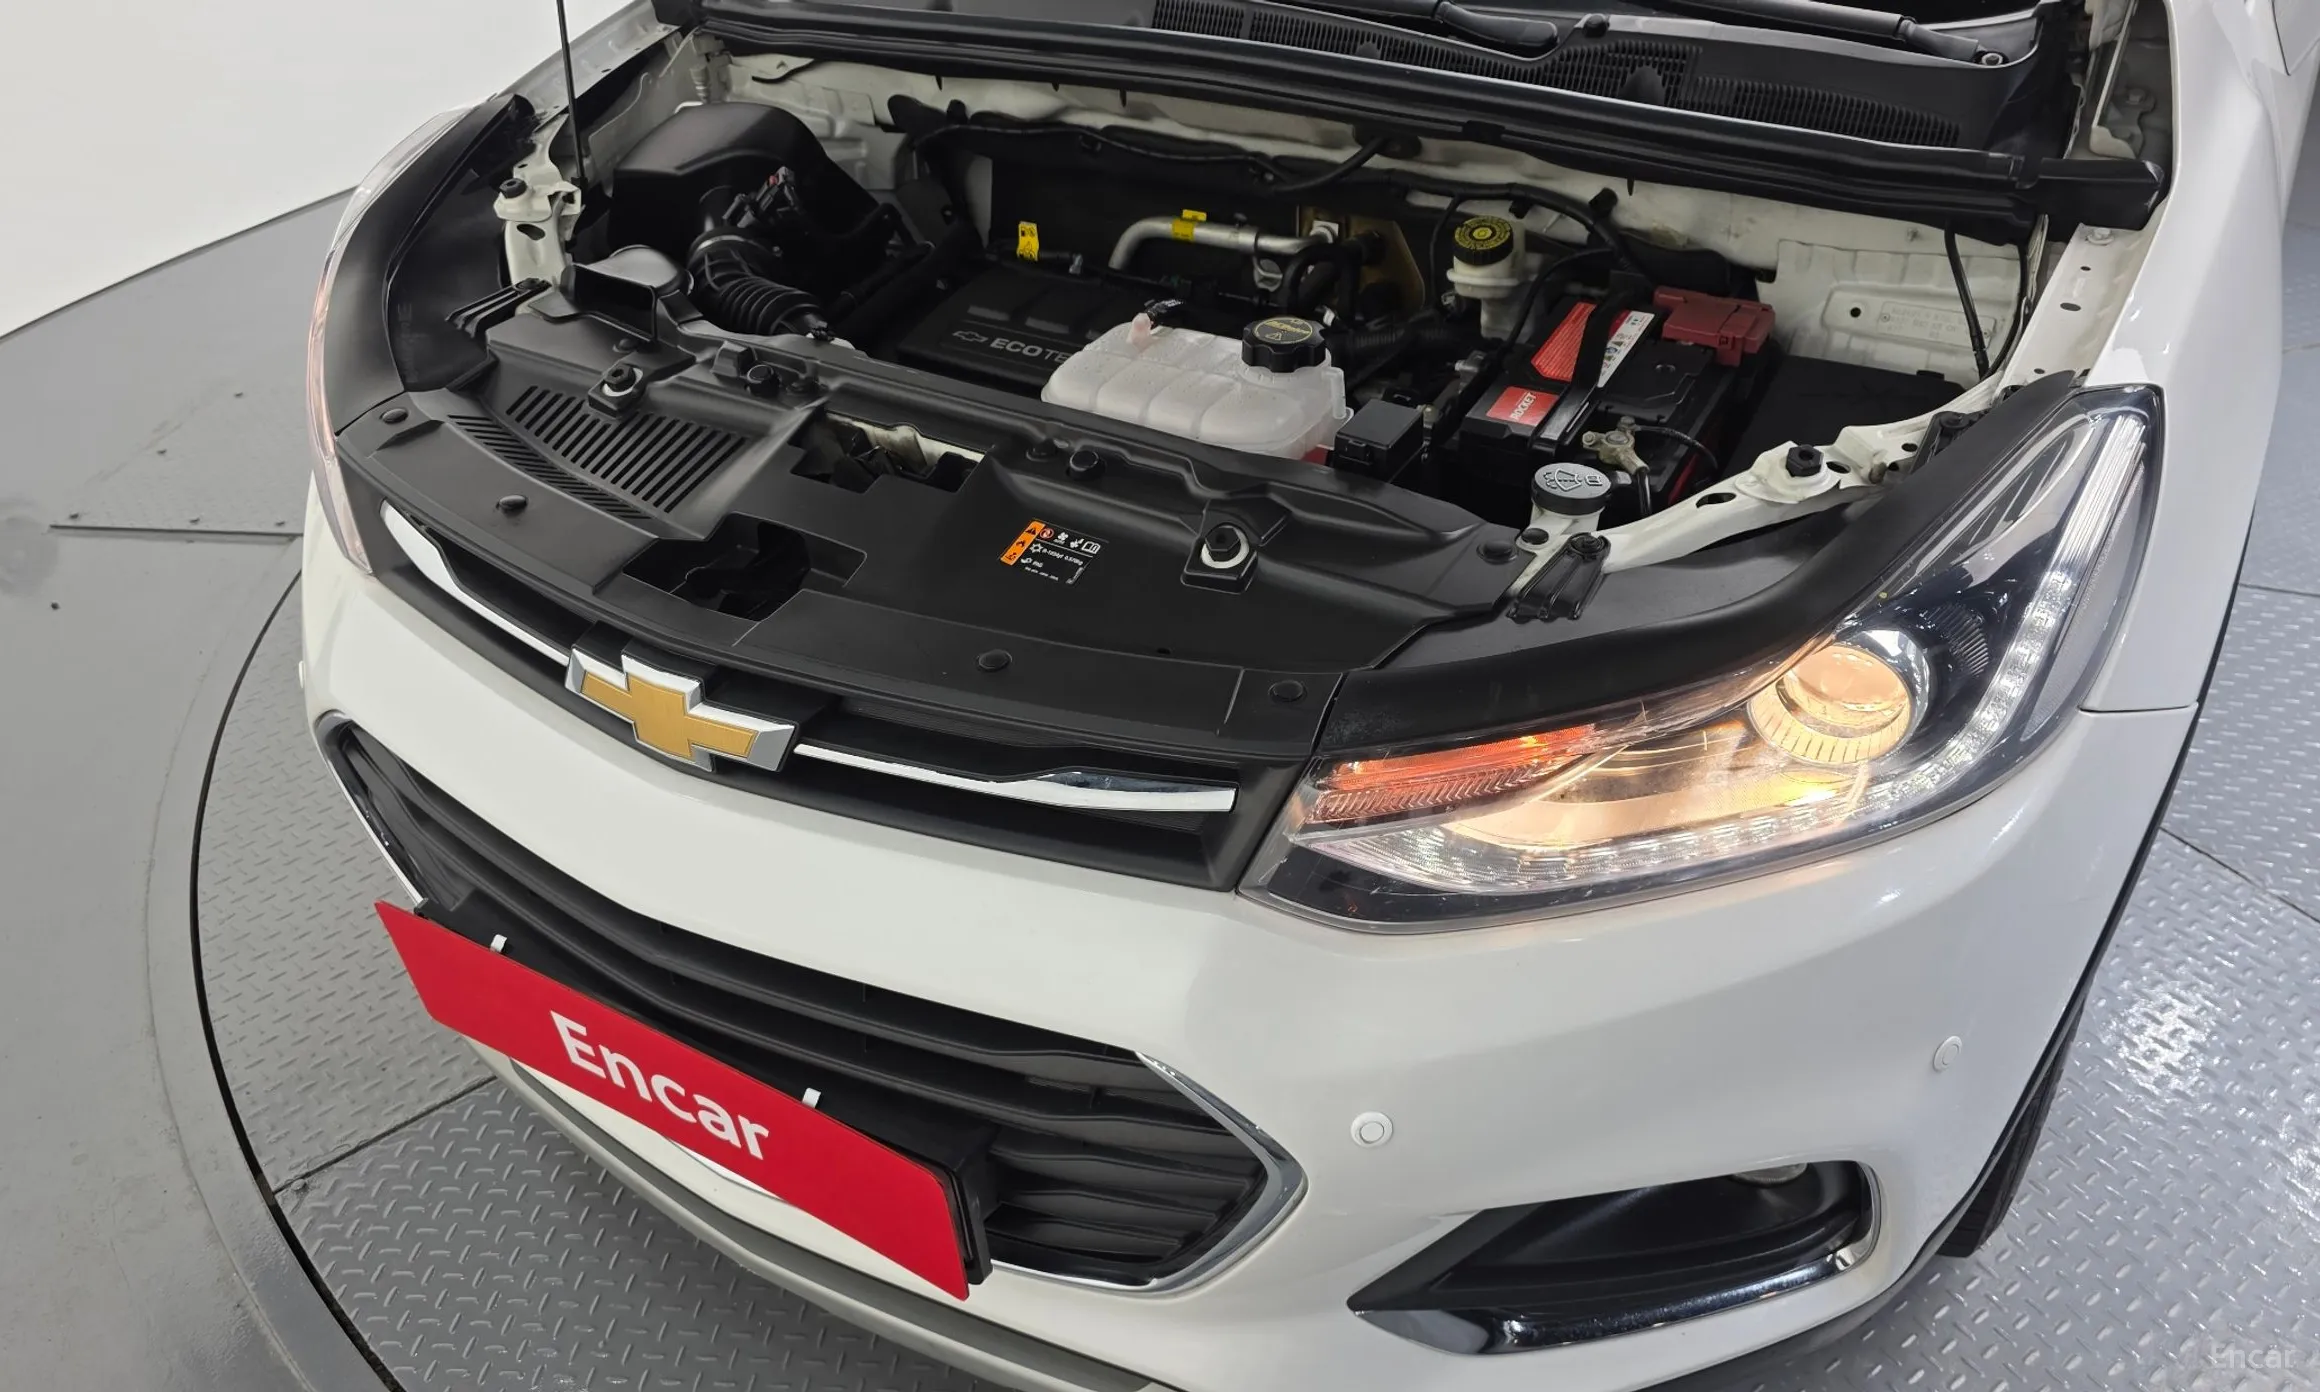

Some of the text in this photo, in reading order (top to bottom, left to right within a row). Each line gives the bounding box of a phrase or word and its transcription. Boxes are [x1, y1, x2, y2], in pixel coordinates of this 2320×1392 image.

[990, 337, 1075, 363] ECOTE
[1509, 391, 1537, 420] ROCKET
[550, 1010, 769, 1160] Encar
